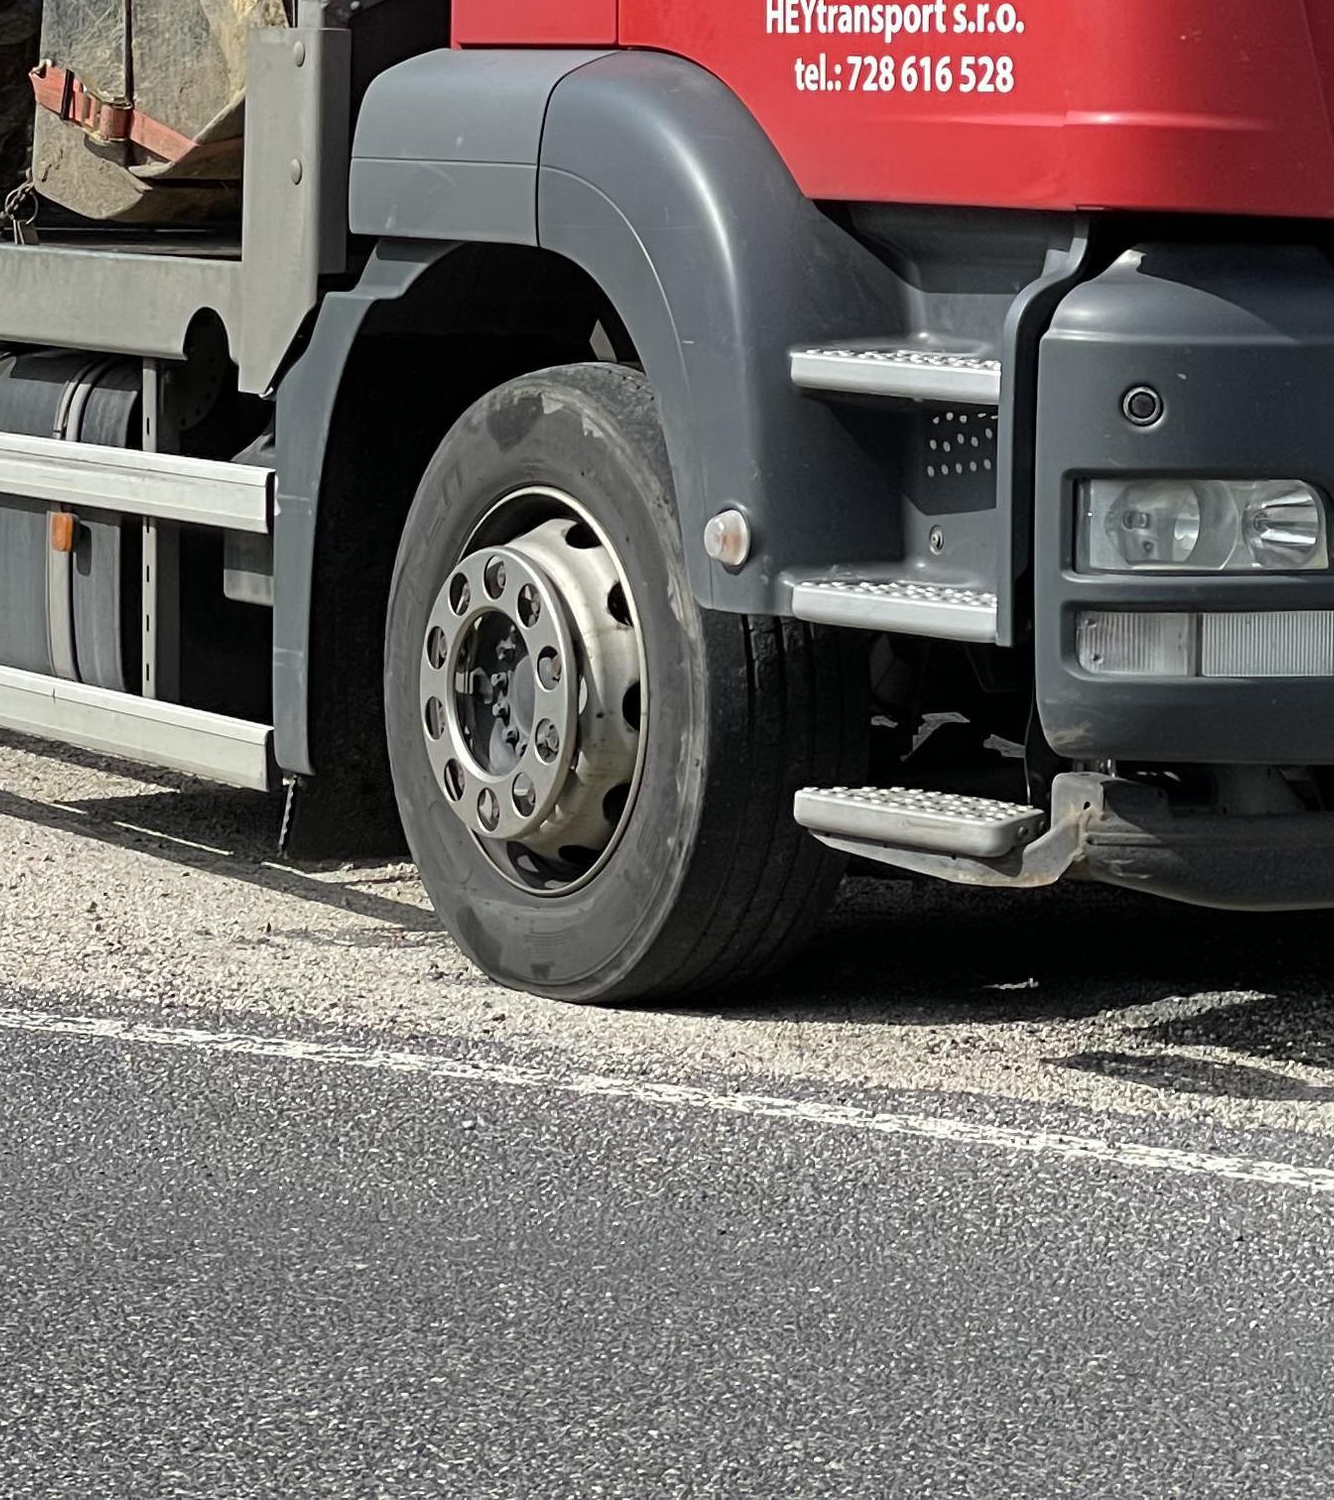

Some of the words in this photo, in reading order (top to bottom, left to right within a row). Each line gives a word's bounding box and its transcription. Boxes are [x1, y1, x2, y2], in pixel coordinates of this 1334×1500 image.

[952, 1, 1025, 34] s.r.o.
[794, 53, 842, 92] tel.:
[847, 55, 896, 92] 728
[901, 55, 953, 92] 616
[958, 55, 1015, 93] 528
